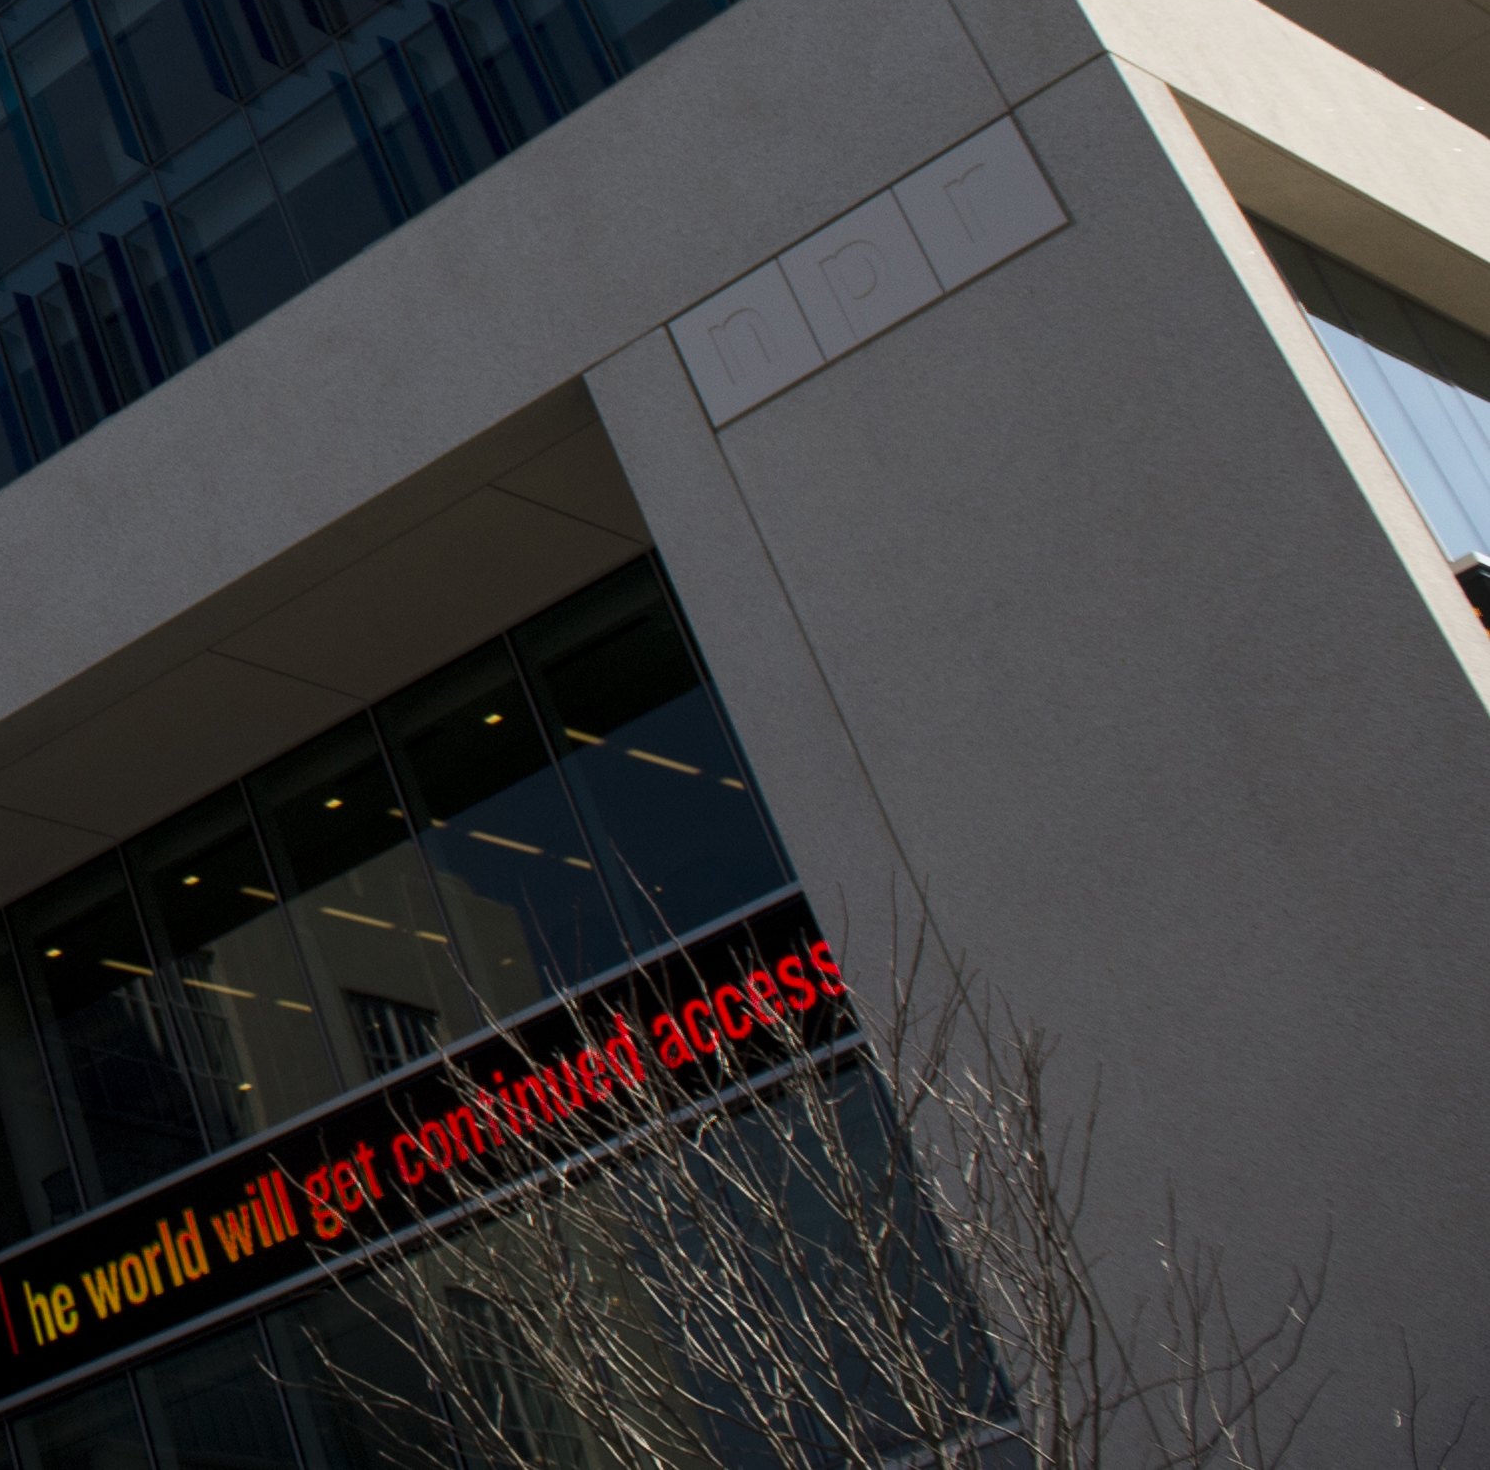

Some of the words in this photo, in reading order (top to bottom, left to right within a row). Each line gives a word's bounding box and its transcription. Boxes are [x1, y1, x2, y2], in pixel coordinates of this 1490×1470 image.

[708, 161, 986, 386] npr
[22, 1280, 80, 1346] he
[81, 1208, 210, 1320] world
[211, 1170, 299, 1263] will
[305, 1141, 384, 1241] get
[391, 1012, 646, 1186] continued
[651, 939, 847, 1070] access
